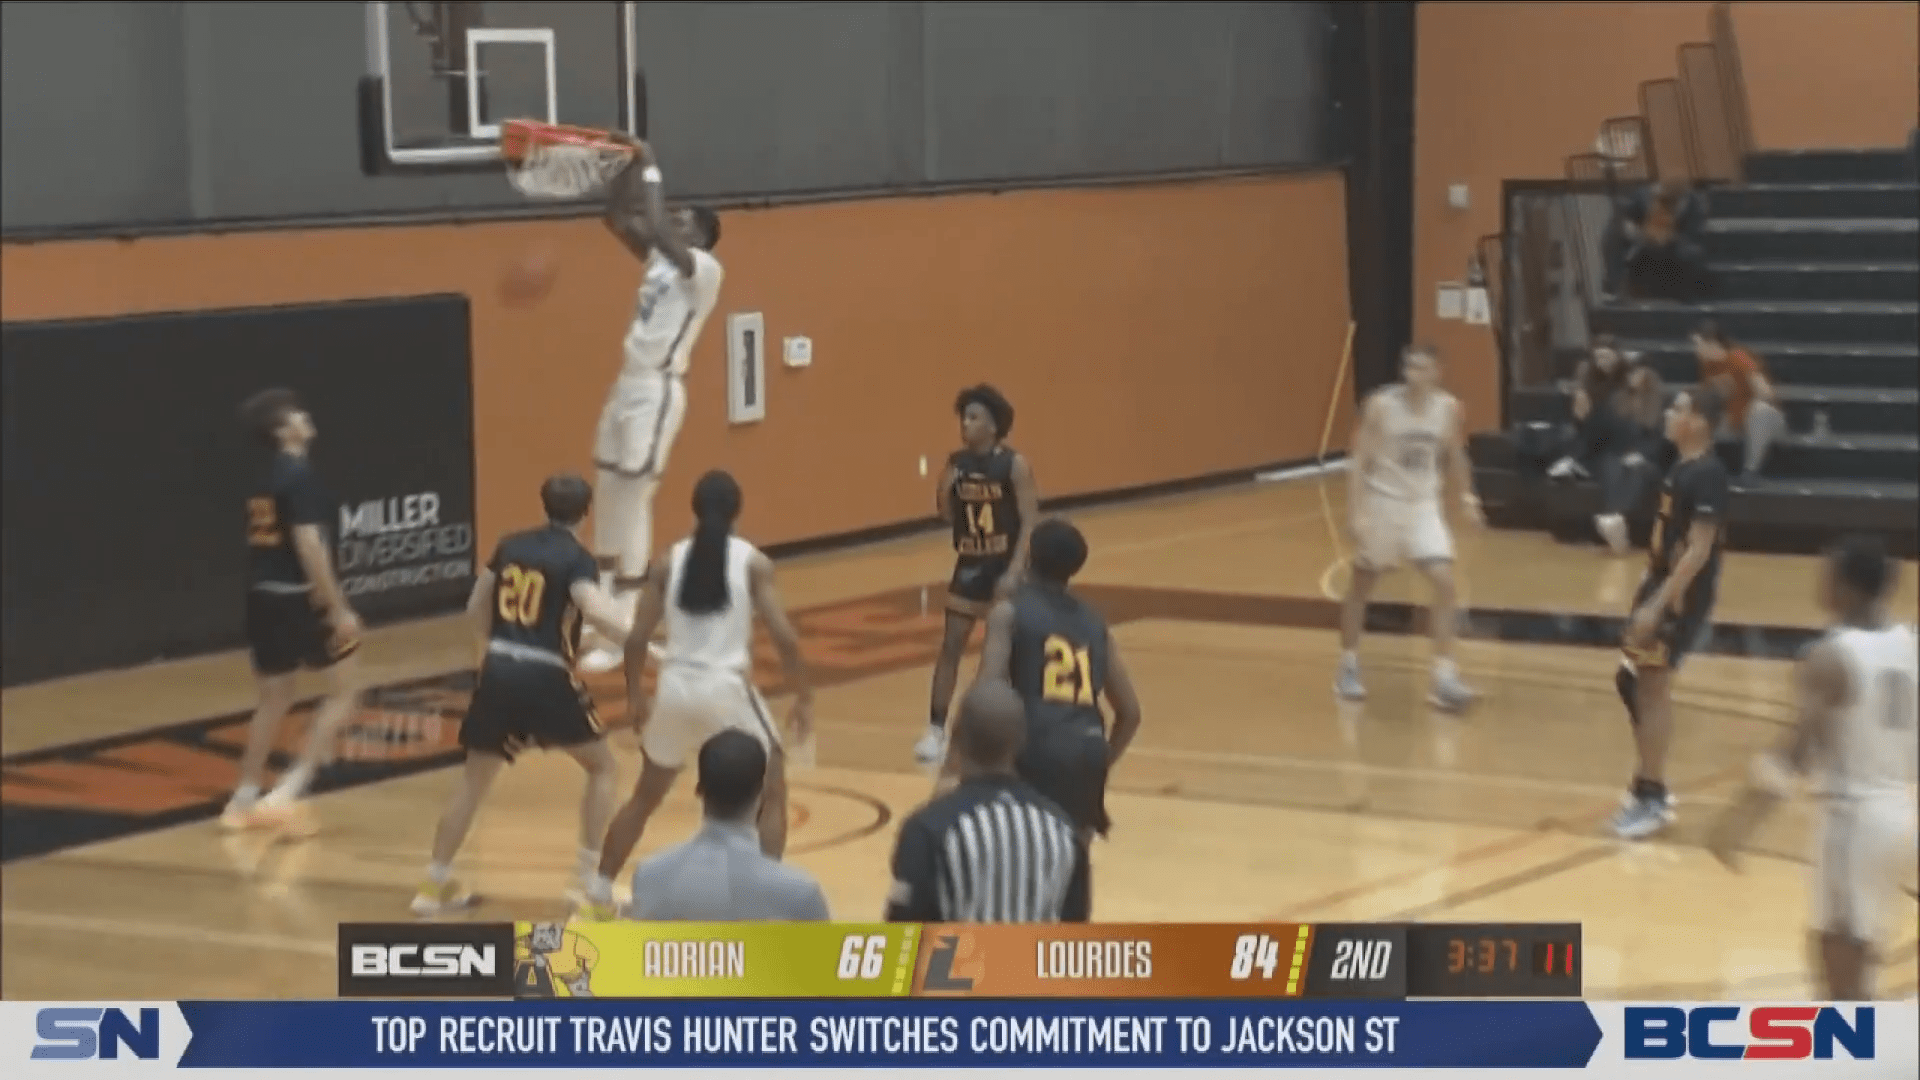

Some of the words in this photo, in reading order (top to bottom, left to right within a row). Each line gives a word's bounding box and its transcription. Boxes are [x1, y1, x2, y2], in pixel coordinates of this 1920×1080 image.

[338, 491, 440, 538] MILLER
[966, 501, 995, 534] 14
[498, 564, 546, 626] 20
[1042, 634, 1094, 706] 21
